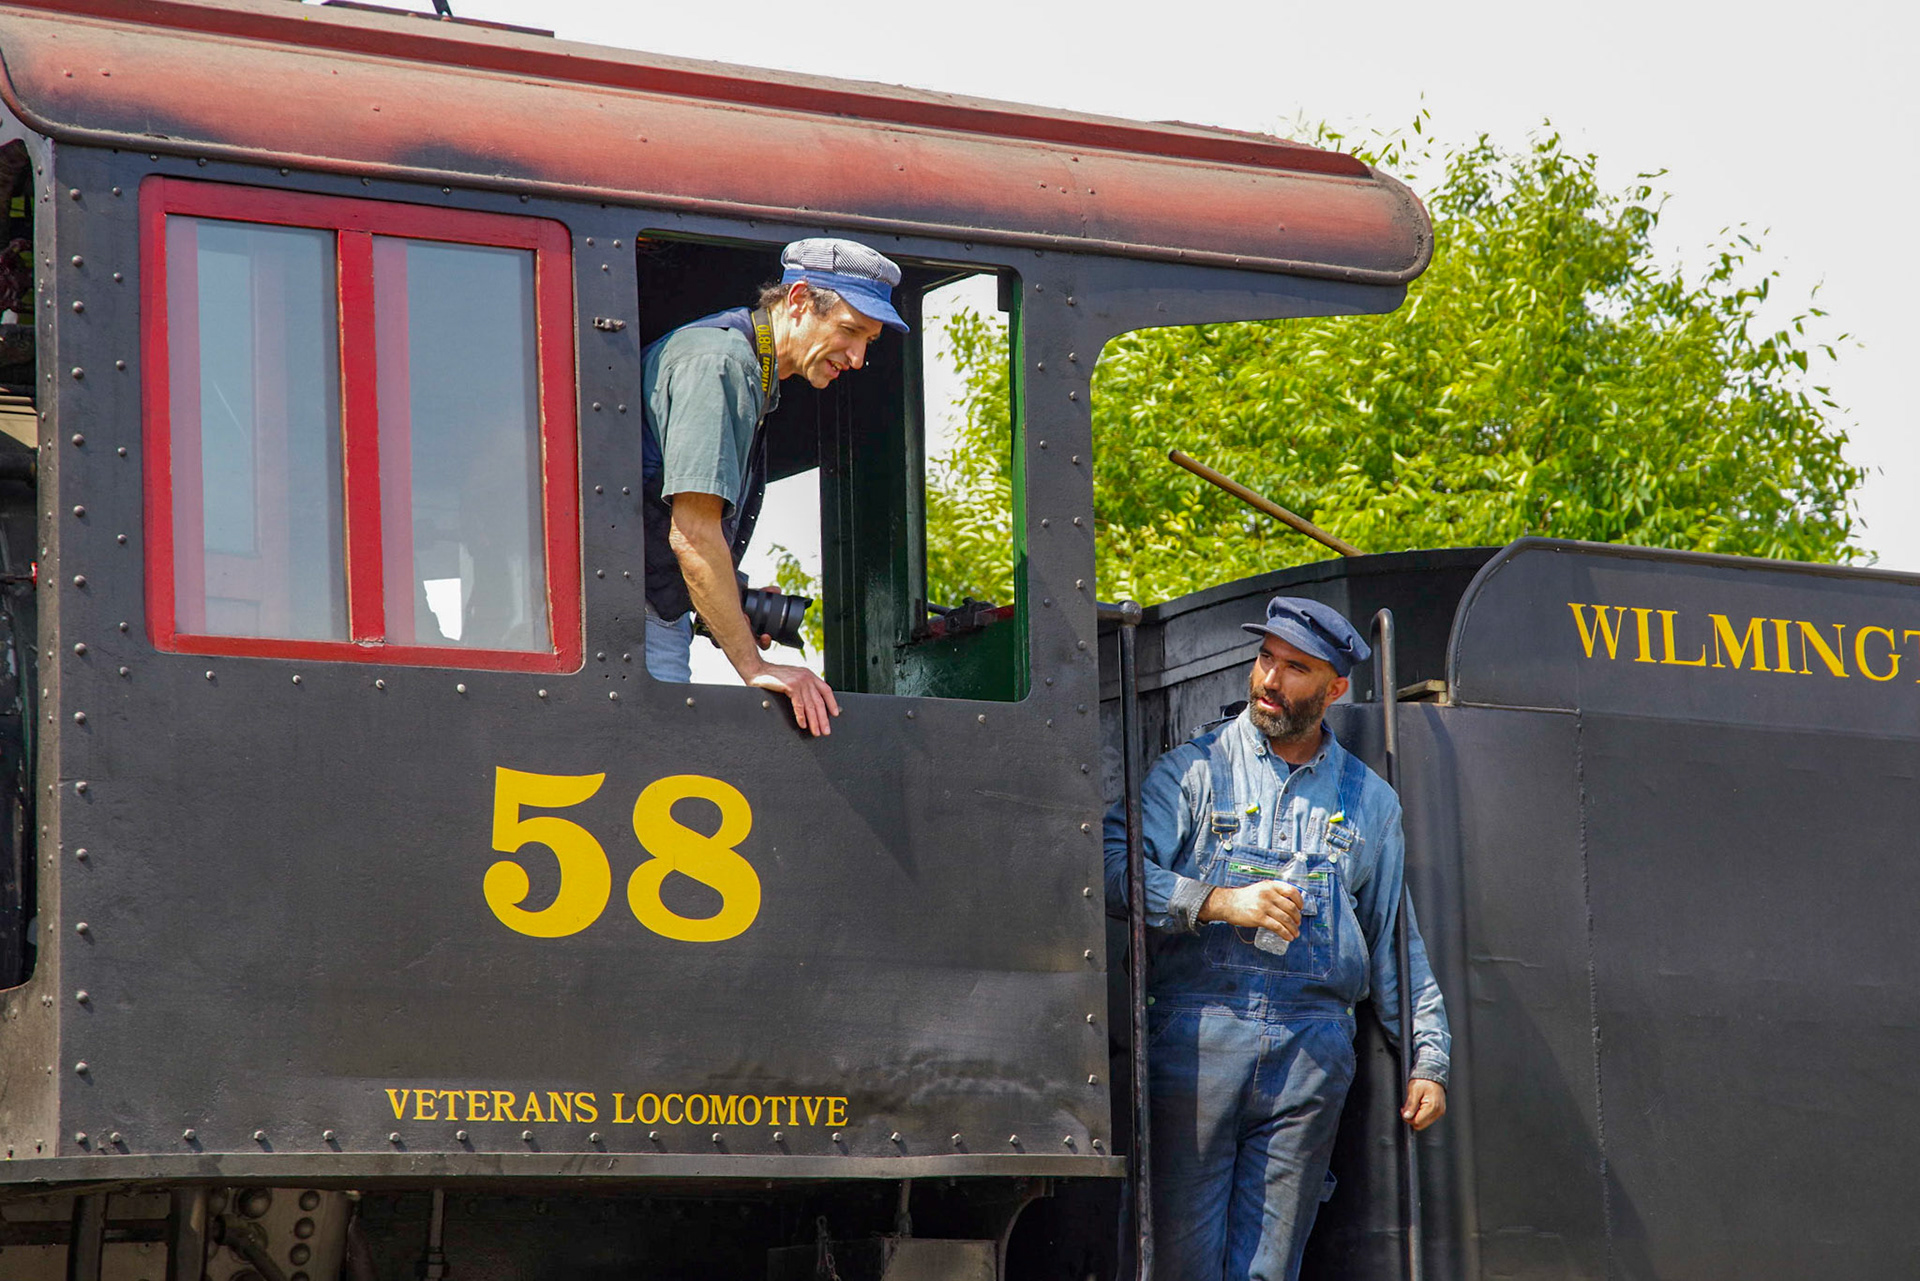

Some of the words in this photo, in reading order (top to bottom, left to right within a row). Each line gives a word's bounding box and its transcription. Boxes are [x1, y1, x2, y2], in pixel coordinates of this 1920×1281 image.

[757, 324, 772, 354] D810
[761, 356, 770, 392] Nikon
[483, 766, 762, 943] 58
[386, 1088, 599, 1123] VETERANS
[612, 1092, 849, 1127] LOCOMOTIVE
